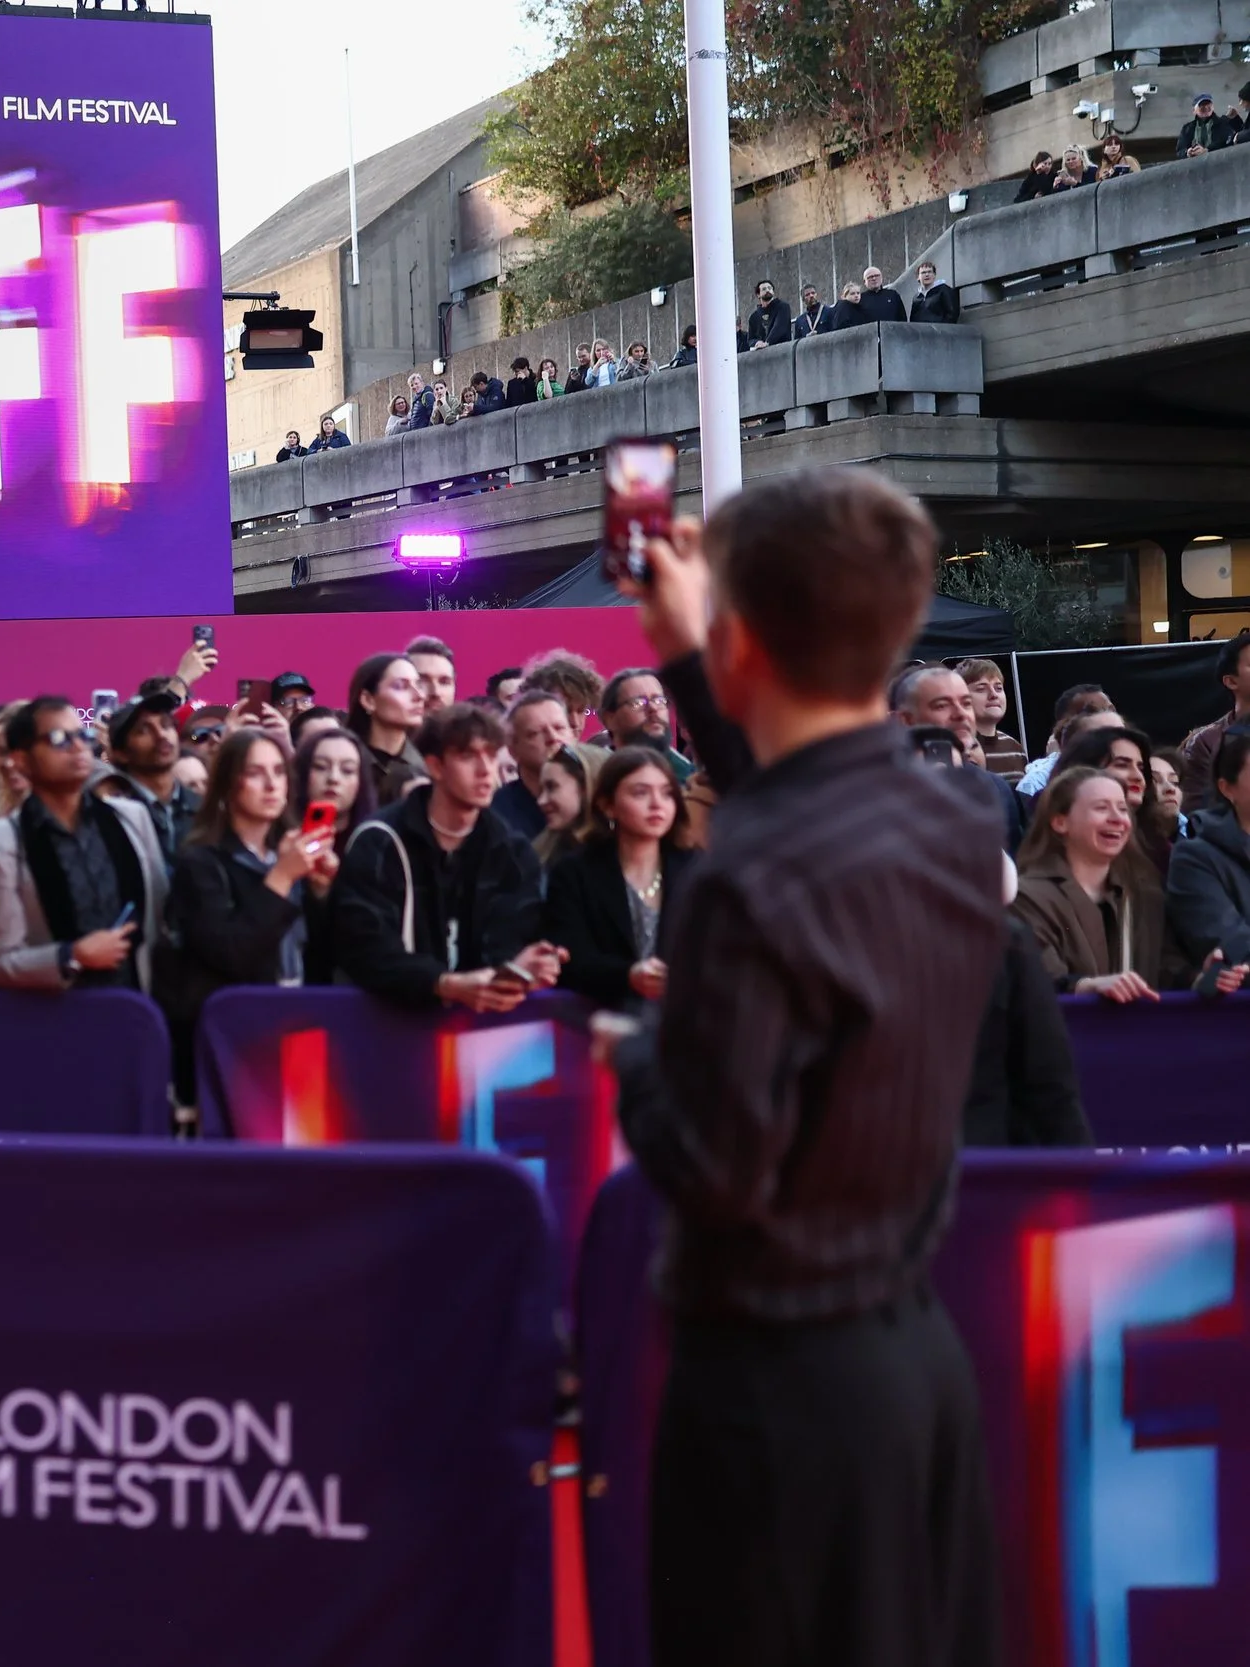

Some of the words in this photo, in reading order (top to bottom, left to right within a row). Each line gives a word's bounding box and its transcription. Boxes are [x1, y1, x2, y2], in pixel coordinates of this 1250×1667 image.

[2, 96, 62, 121] FILM
[68, 98, 177, 126] FESTIVAL
[33, 1456, 369, 1541] FESTIVAL
